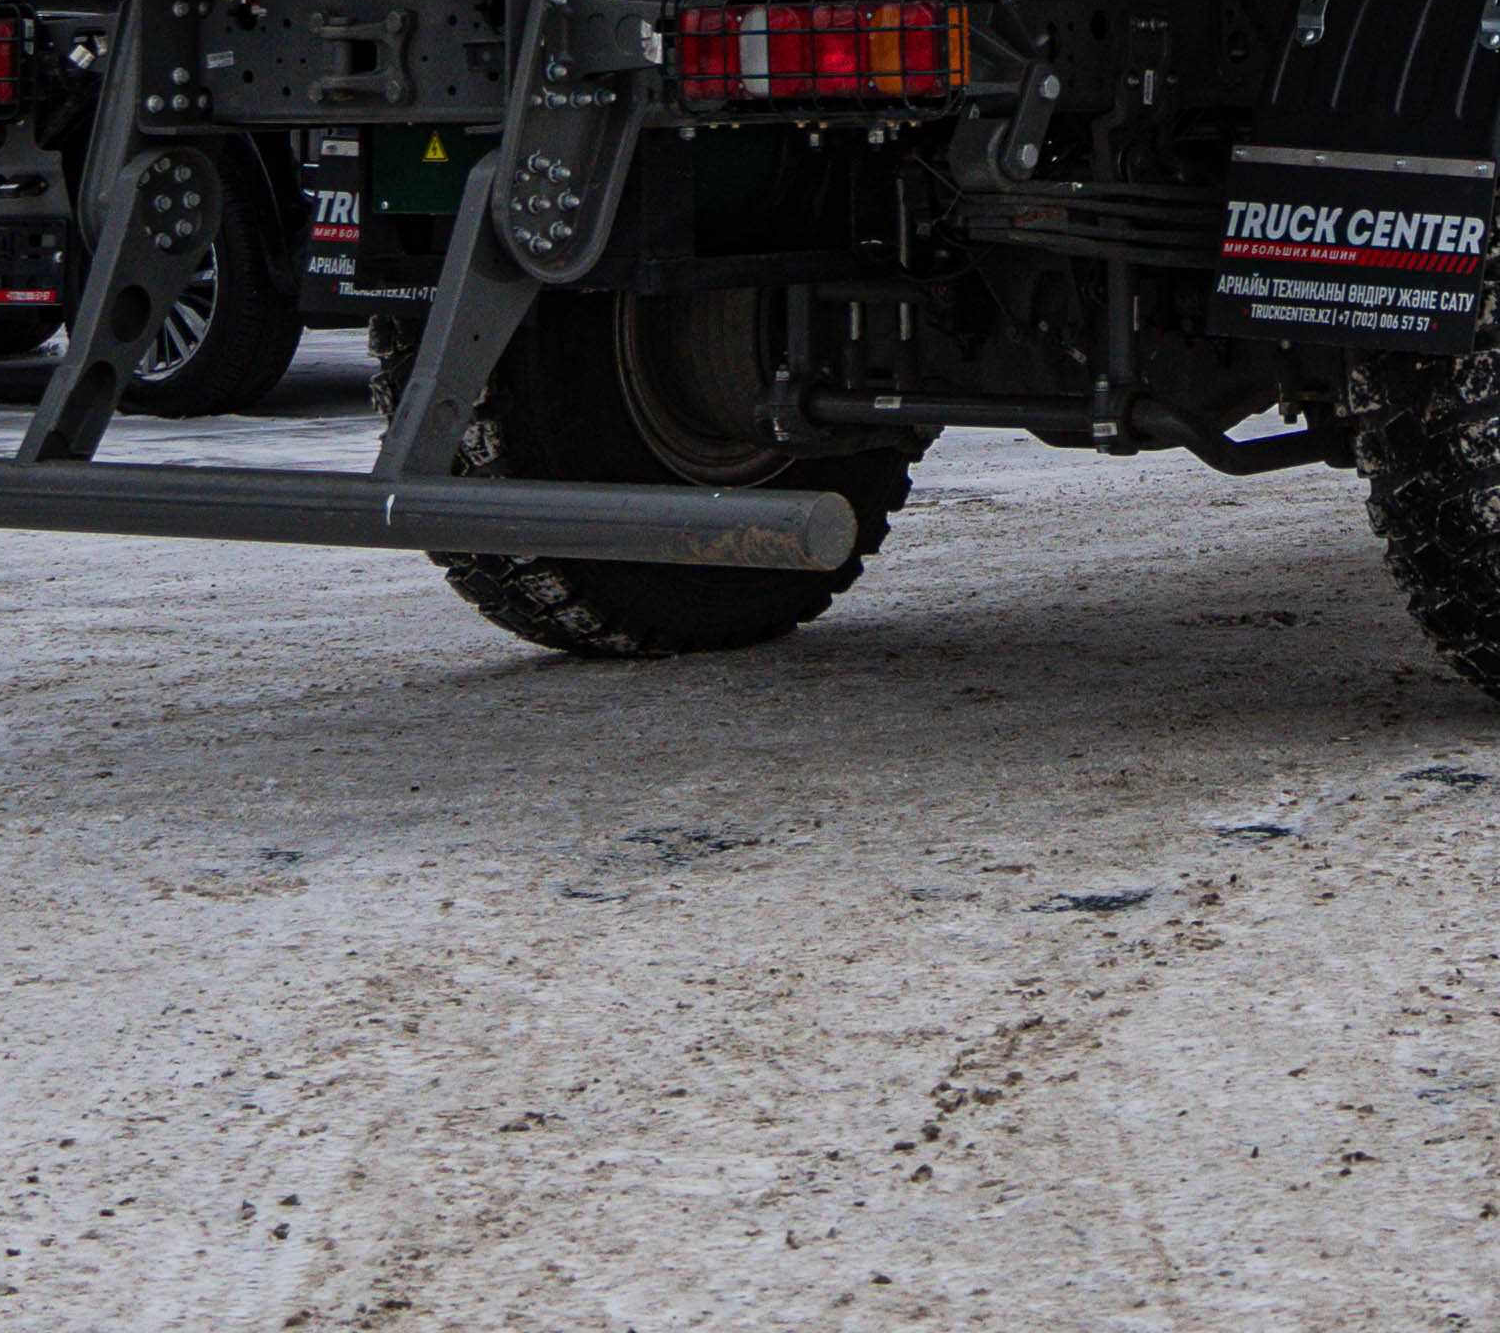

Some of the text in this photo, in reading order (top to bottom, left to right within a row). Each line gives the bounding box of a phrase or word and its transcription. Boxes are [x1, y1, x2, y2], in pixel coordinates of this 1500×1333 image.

[1225, 201, 1485, 255] TRUCK CENTER
[308, 254, 356, 276] АРНАЙЫ
[1223, 242, 1357, 262] МИР БОЛЬШИХ МАШИН
[1217, 273, 1475, 313] АРНАЙЫ ТЕХНИКАНЫ ӨНДІРУ ЖӘНЕ САТУ
[1251, 303, 1330, 324] TRUCKCENTER.KZ
[1338, 311, 1351, 326] +7
[1351, 312, 1378, 329] (702)
[1380, 314, 1399, 330] 006
[1401, 316, 1415, 331] 57
[1416, 317, 1430, 332] 57
